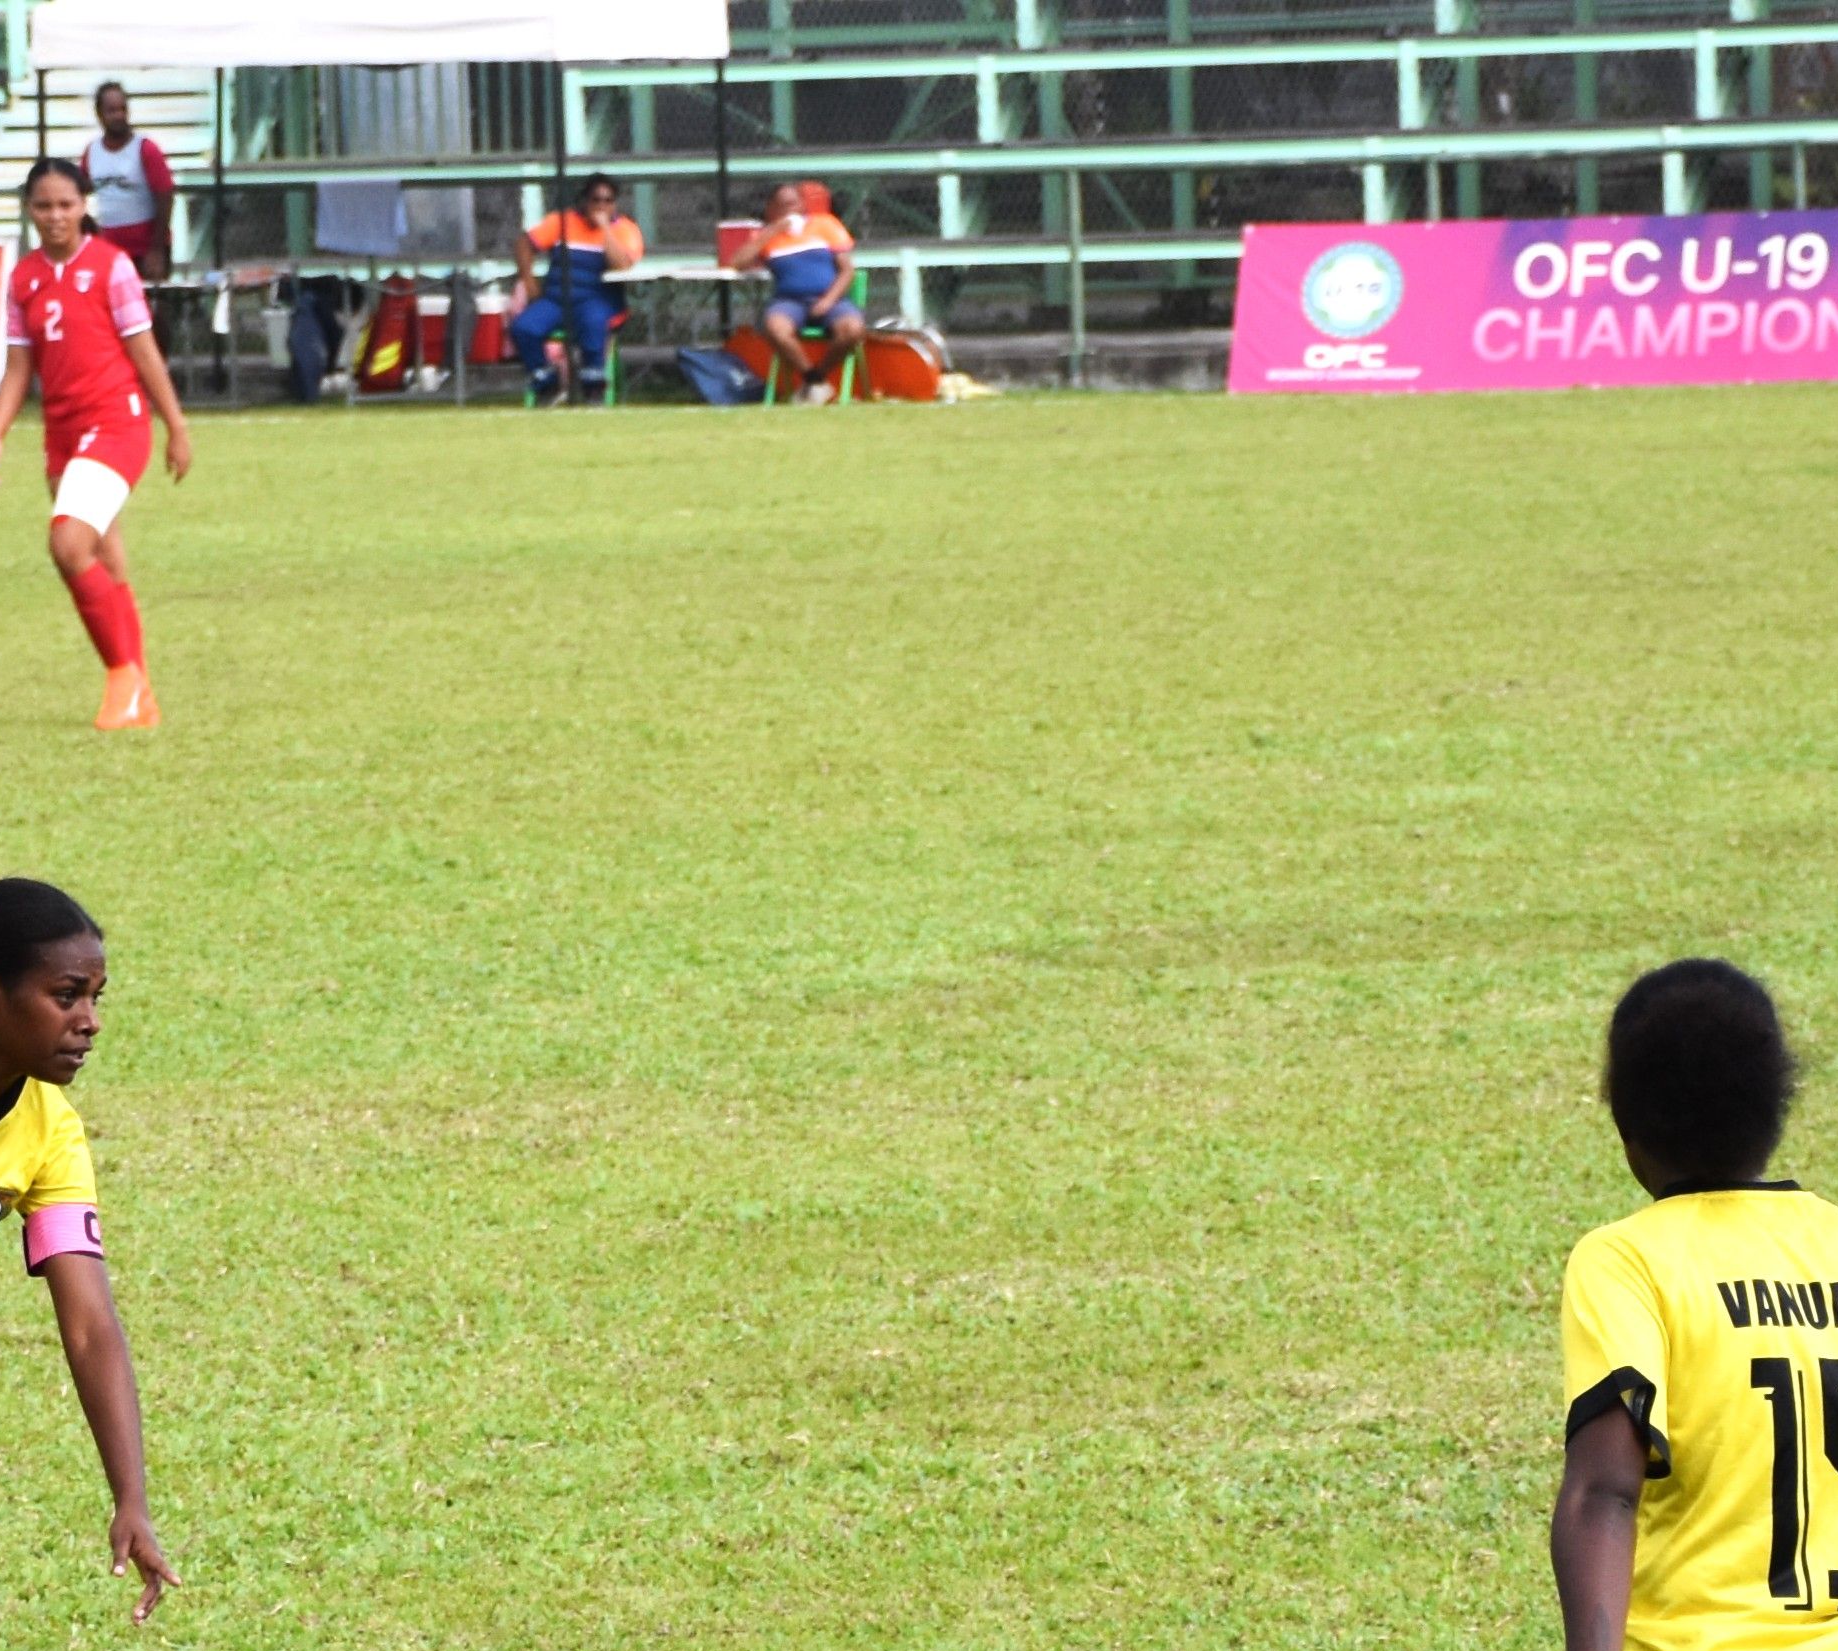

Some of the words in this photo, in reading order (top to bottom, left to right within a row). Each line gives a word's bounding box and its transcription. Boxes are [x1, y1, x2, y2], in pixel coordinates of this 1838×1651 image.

[1513, 238, 1662, 299] OFC
[1680, 232, 1830, 294] U-19
[44, 301, 64, 342] 2
[1303, 343, 1388, 369] OFC
